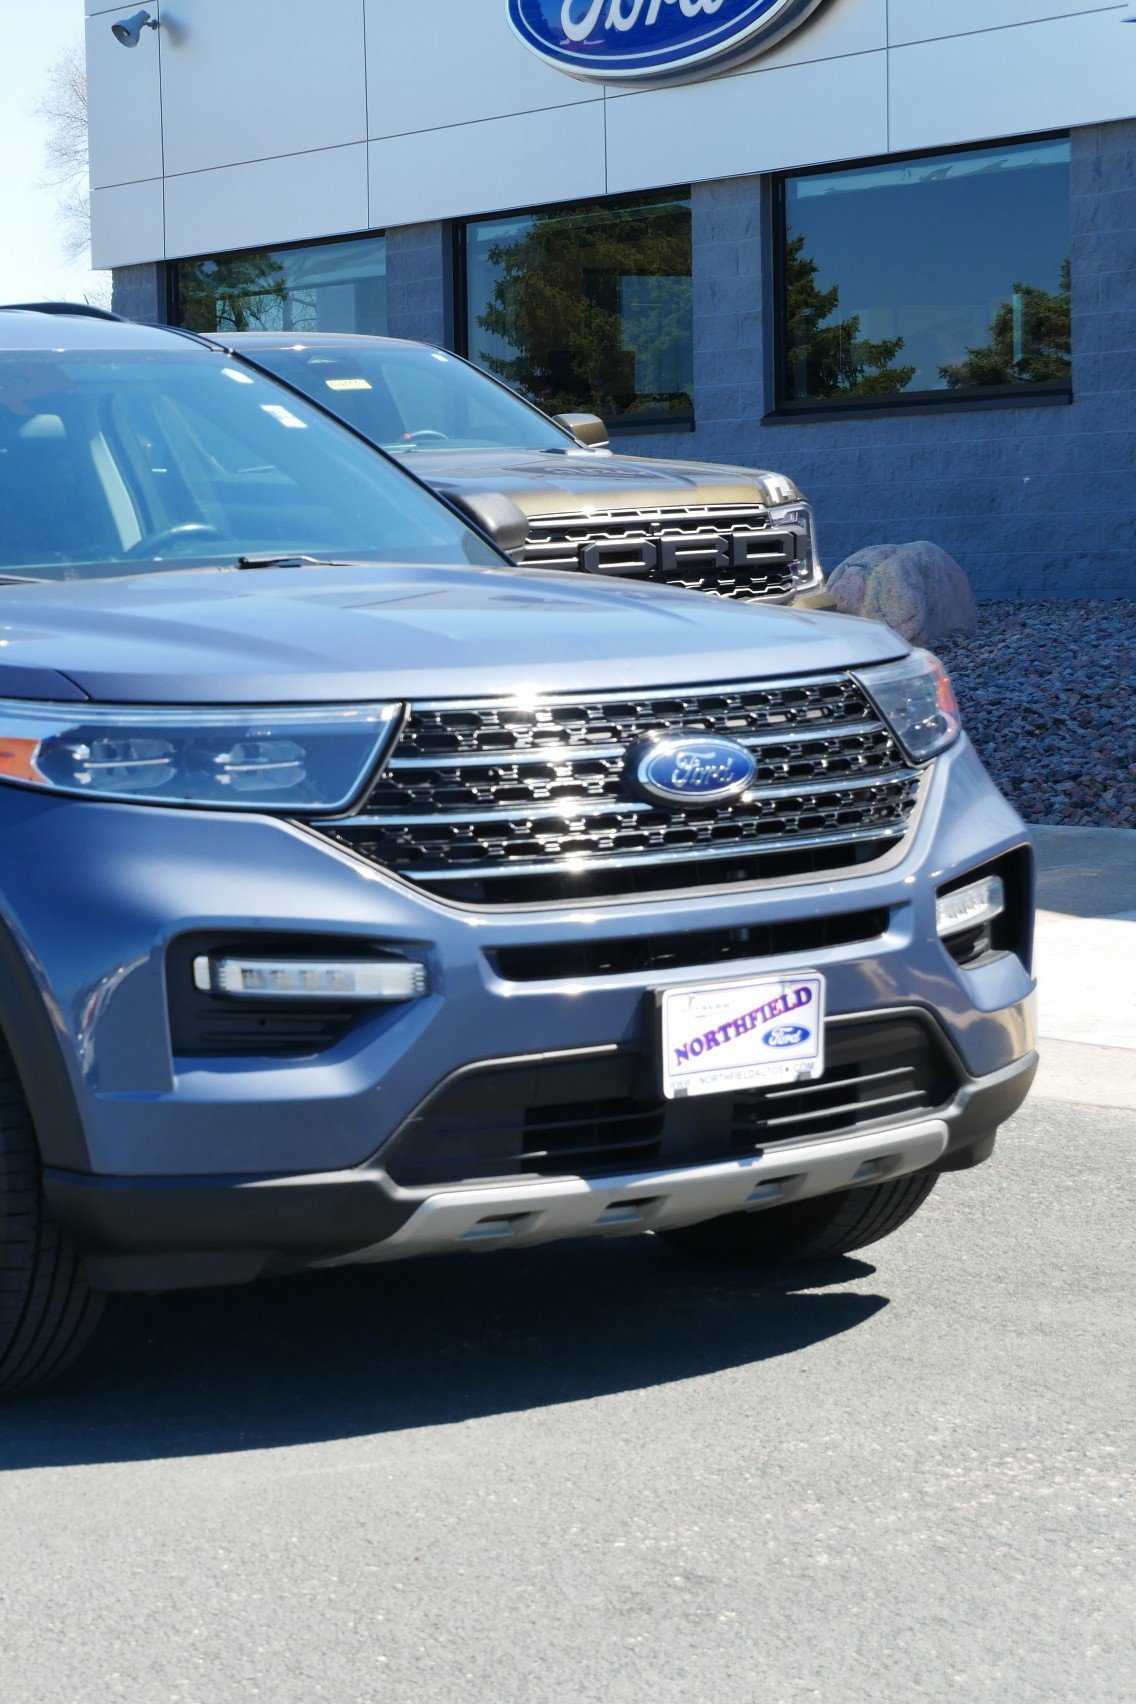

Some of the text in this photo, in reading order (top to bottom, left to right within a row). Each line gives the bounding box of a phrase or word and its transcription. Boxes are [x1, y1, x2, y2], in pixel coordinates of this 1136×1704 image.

[672, 752, 733, 787] Ford
[674, 986, 812, 1065] NORTHFIELD
[767, 1026, 802, 1046] Ford
